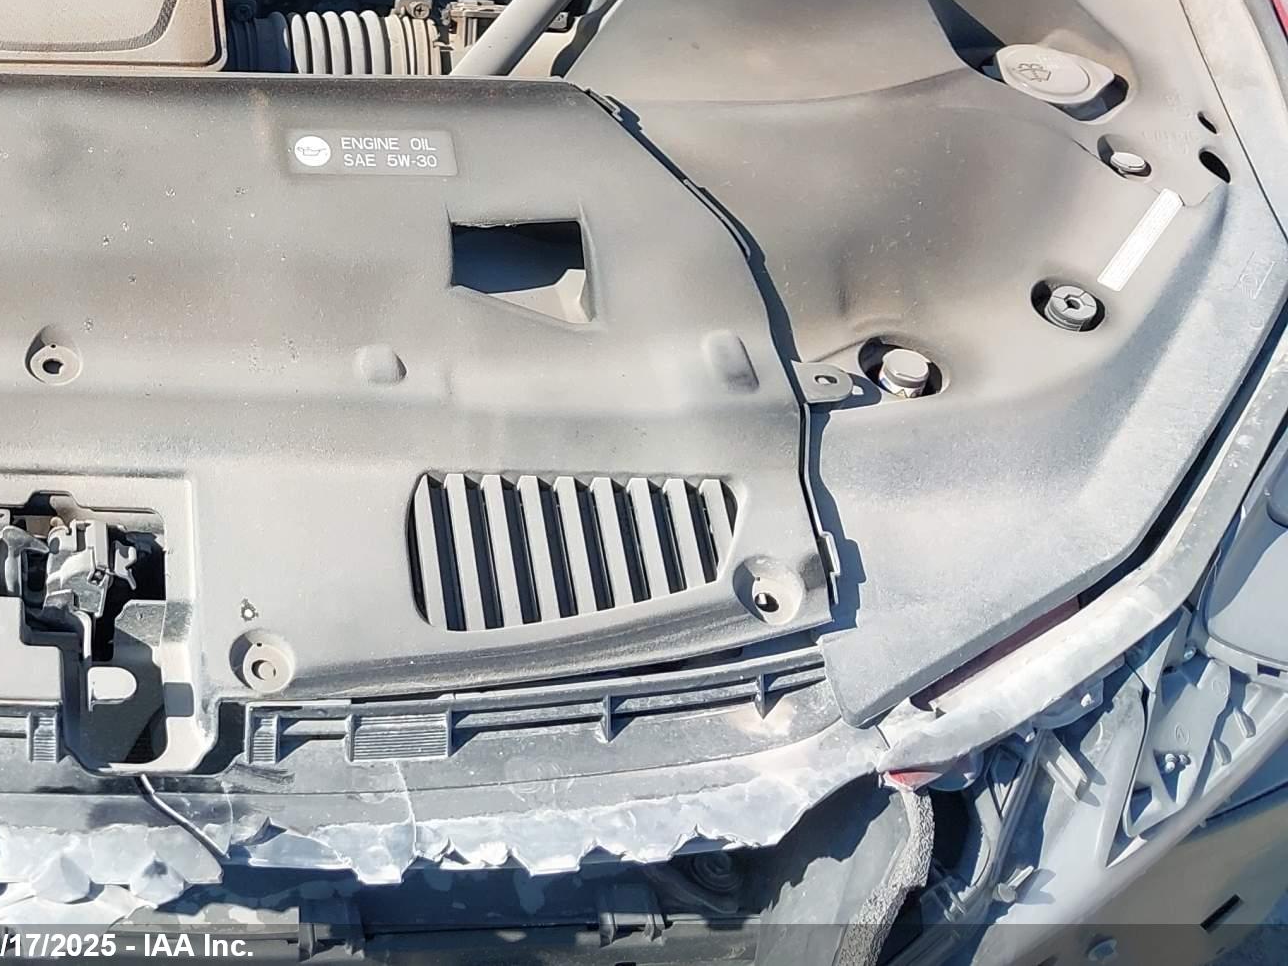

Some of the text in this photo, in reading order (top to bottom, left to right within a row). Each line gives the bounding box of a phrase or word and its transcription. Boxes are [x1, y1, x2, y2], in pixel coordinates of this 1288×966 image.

[340, 136, 437, 151] ENGINE OIL
[343, 153, 438, 168] SAE 5W-30
